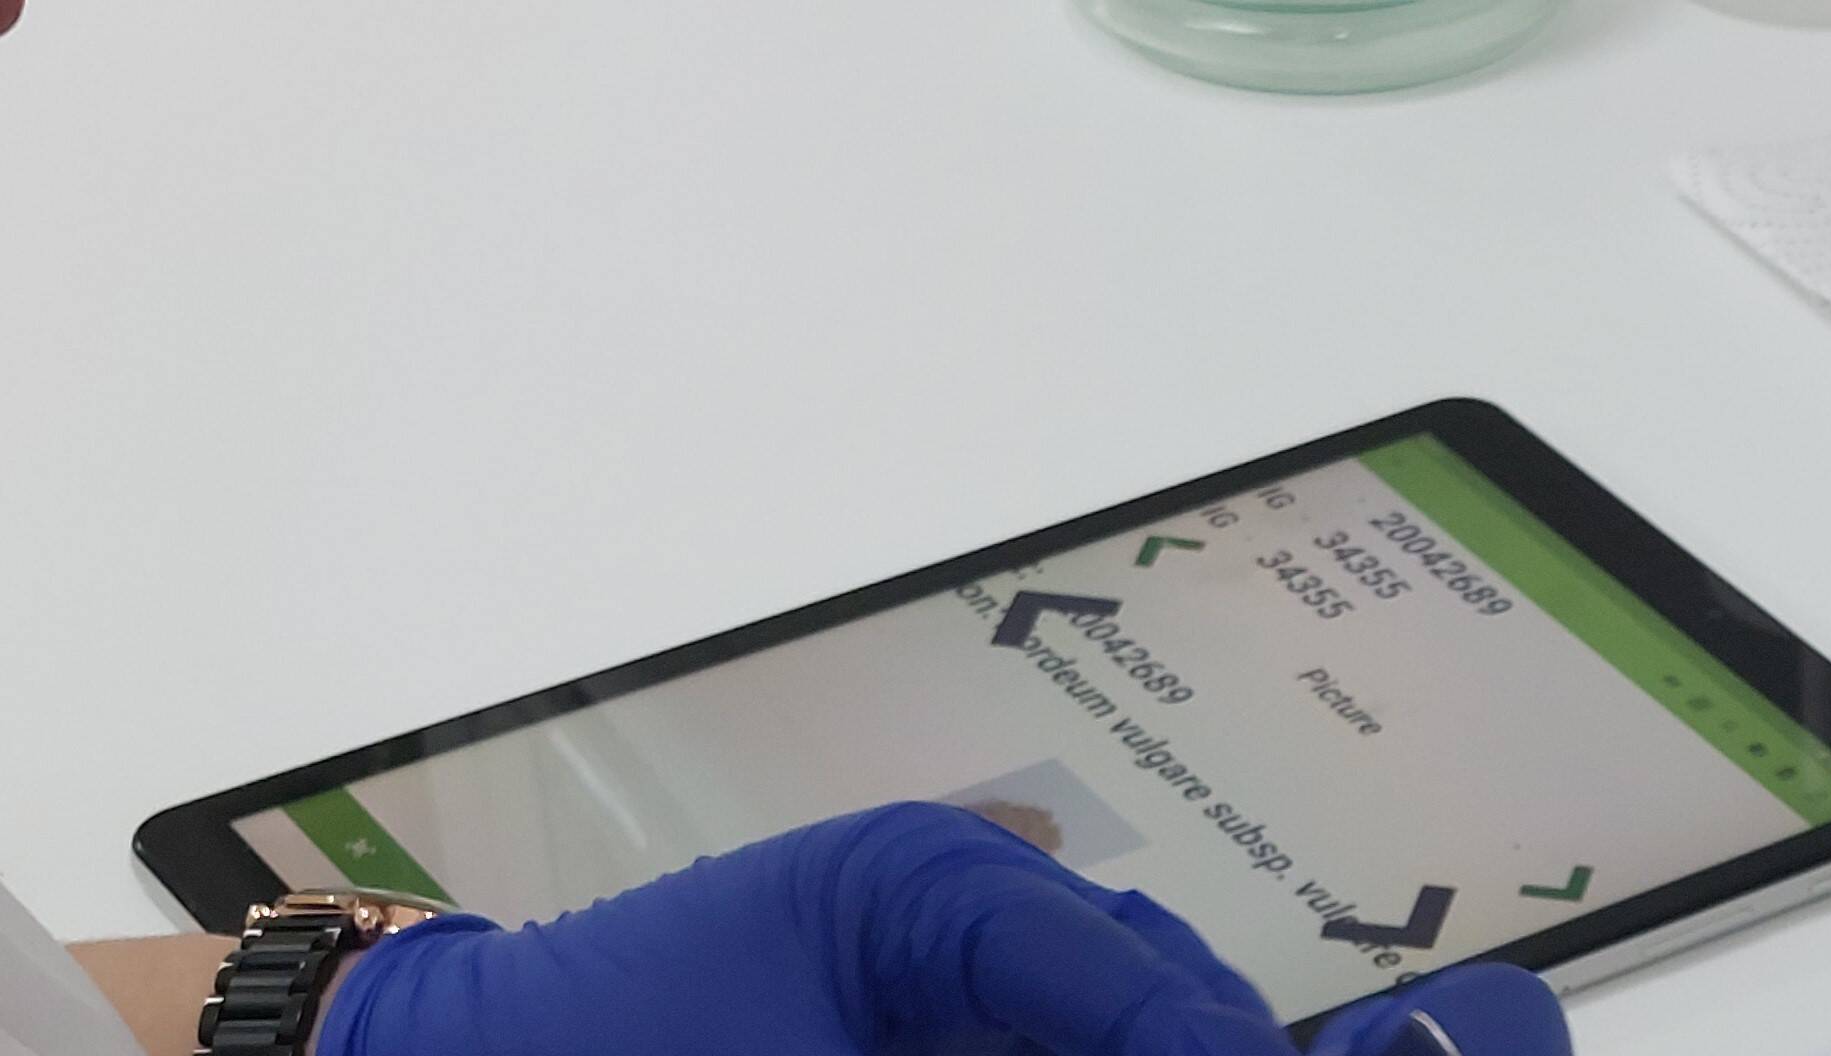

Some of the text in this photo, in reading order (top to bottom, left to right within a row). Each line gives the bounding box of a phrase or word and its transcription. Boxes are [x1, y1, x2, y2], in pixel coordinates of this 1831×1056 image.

[1256, 550, 1356, 620] 34355
[1314, 531, 1413, 601] 34355
[1368, 510, 1514, 617] 20042689
[1066, 611, 1194, 704] 0042689
[1297, 668, 1383, 736] Picture
[1008, 622, 1117, 719] ordeum
[1110, 717, 1212, 801] vulgare
[1203, 803, 1293, 881] subsp.
[1295, 880, 1402, 968] vulre
